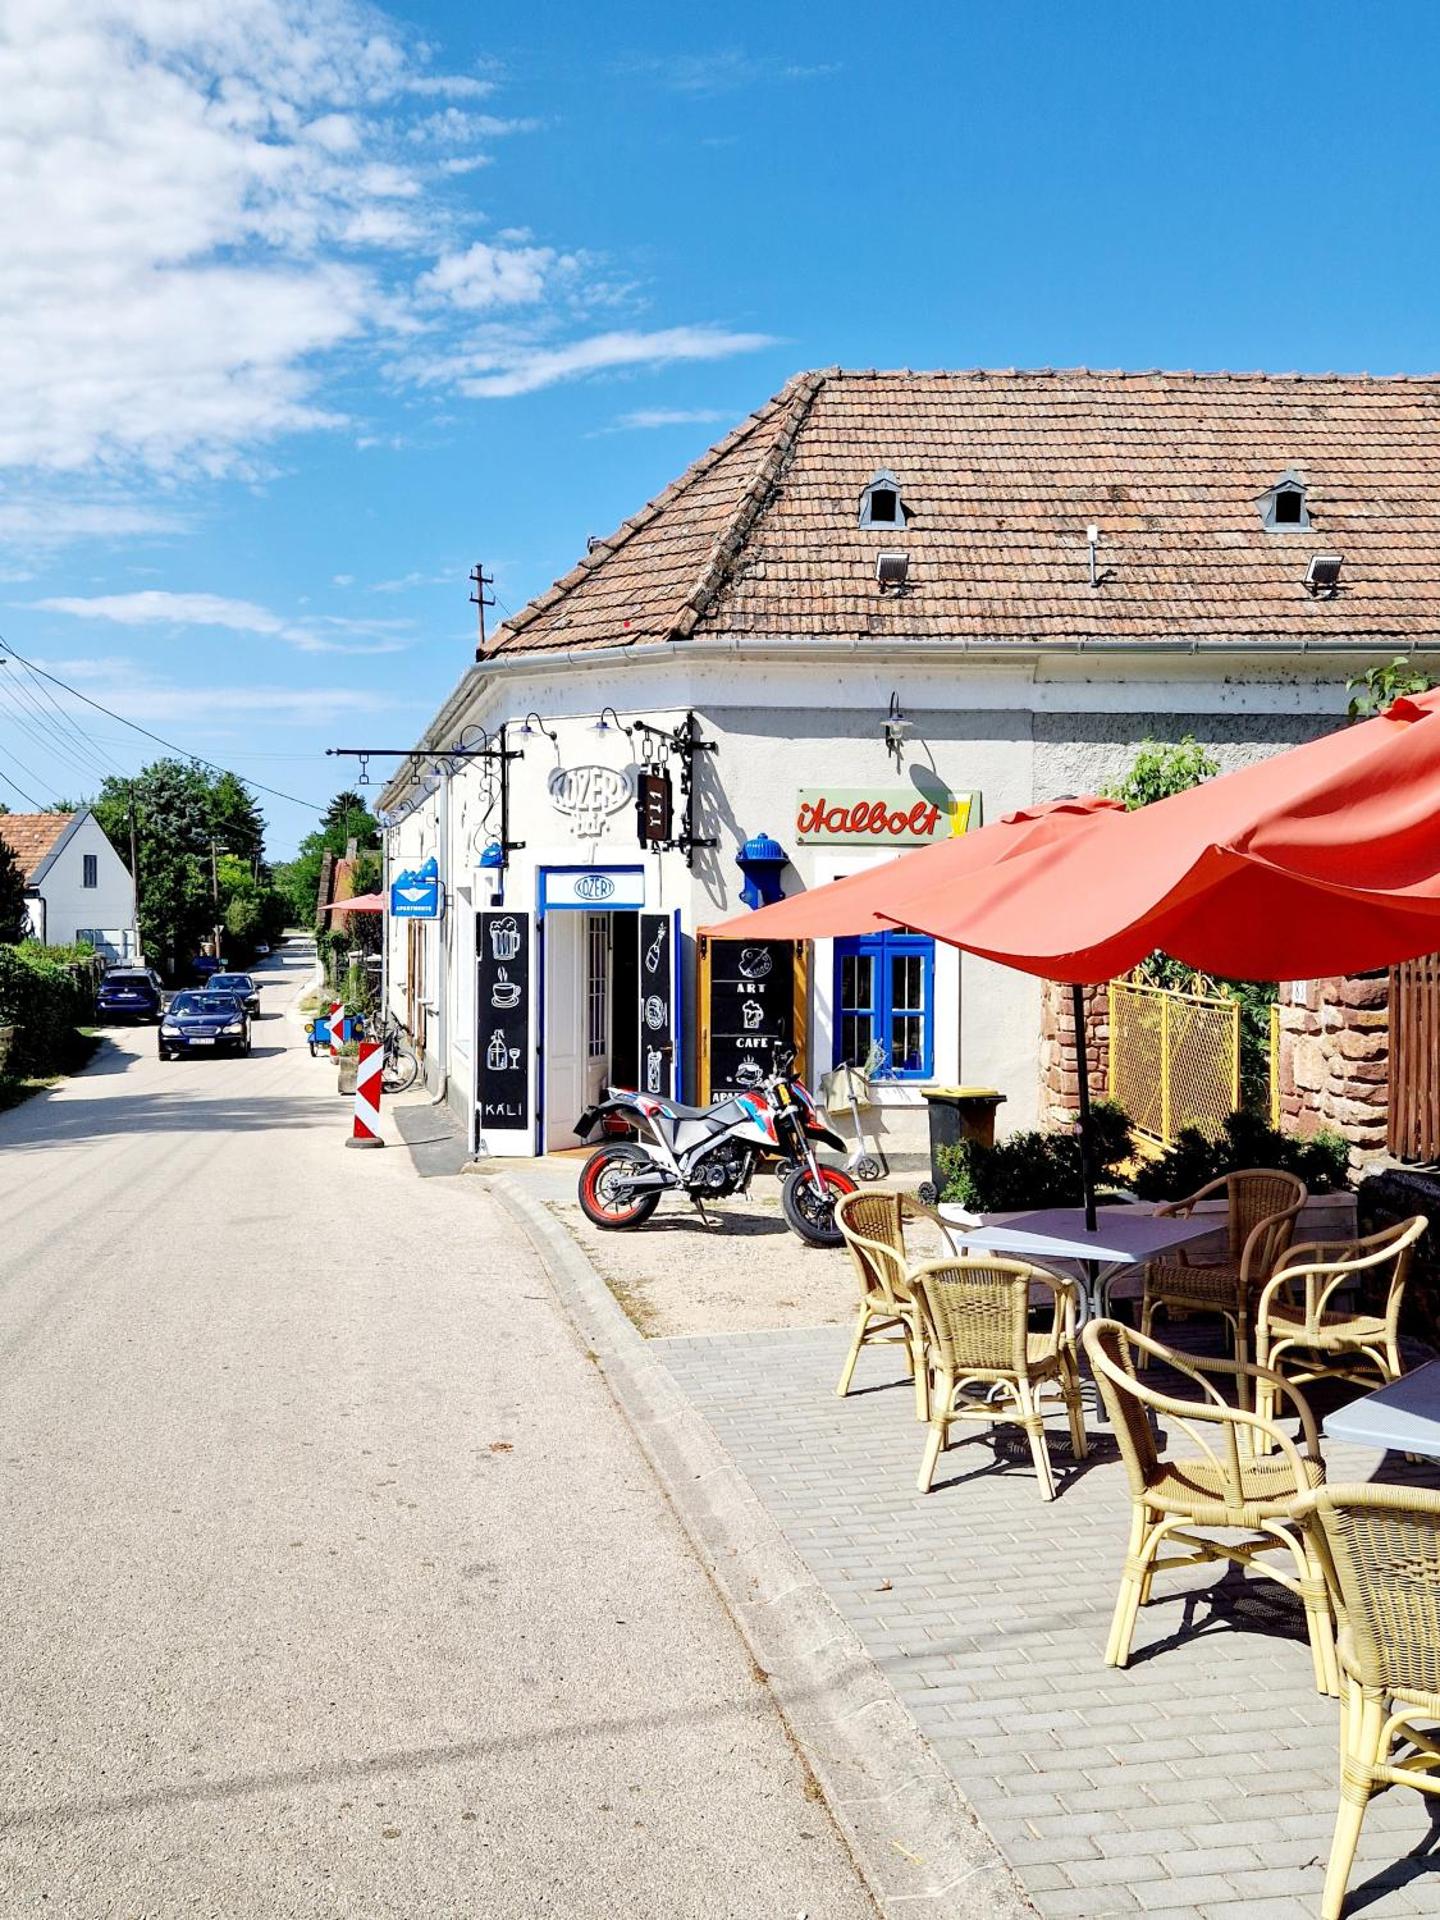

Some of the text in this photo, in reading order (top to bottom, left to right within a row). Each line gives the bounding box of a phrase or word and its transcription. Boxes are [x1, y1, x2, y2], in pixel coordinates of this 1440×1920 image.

[797, 798, 942, 836] italbolt
[737, 983, 766, 993] ART
[736, 1037, 768, 1048] CAFE
